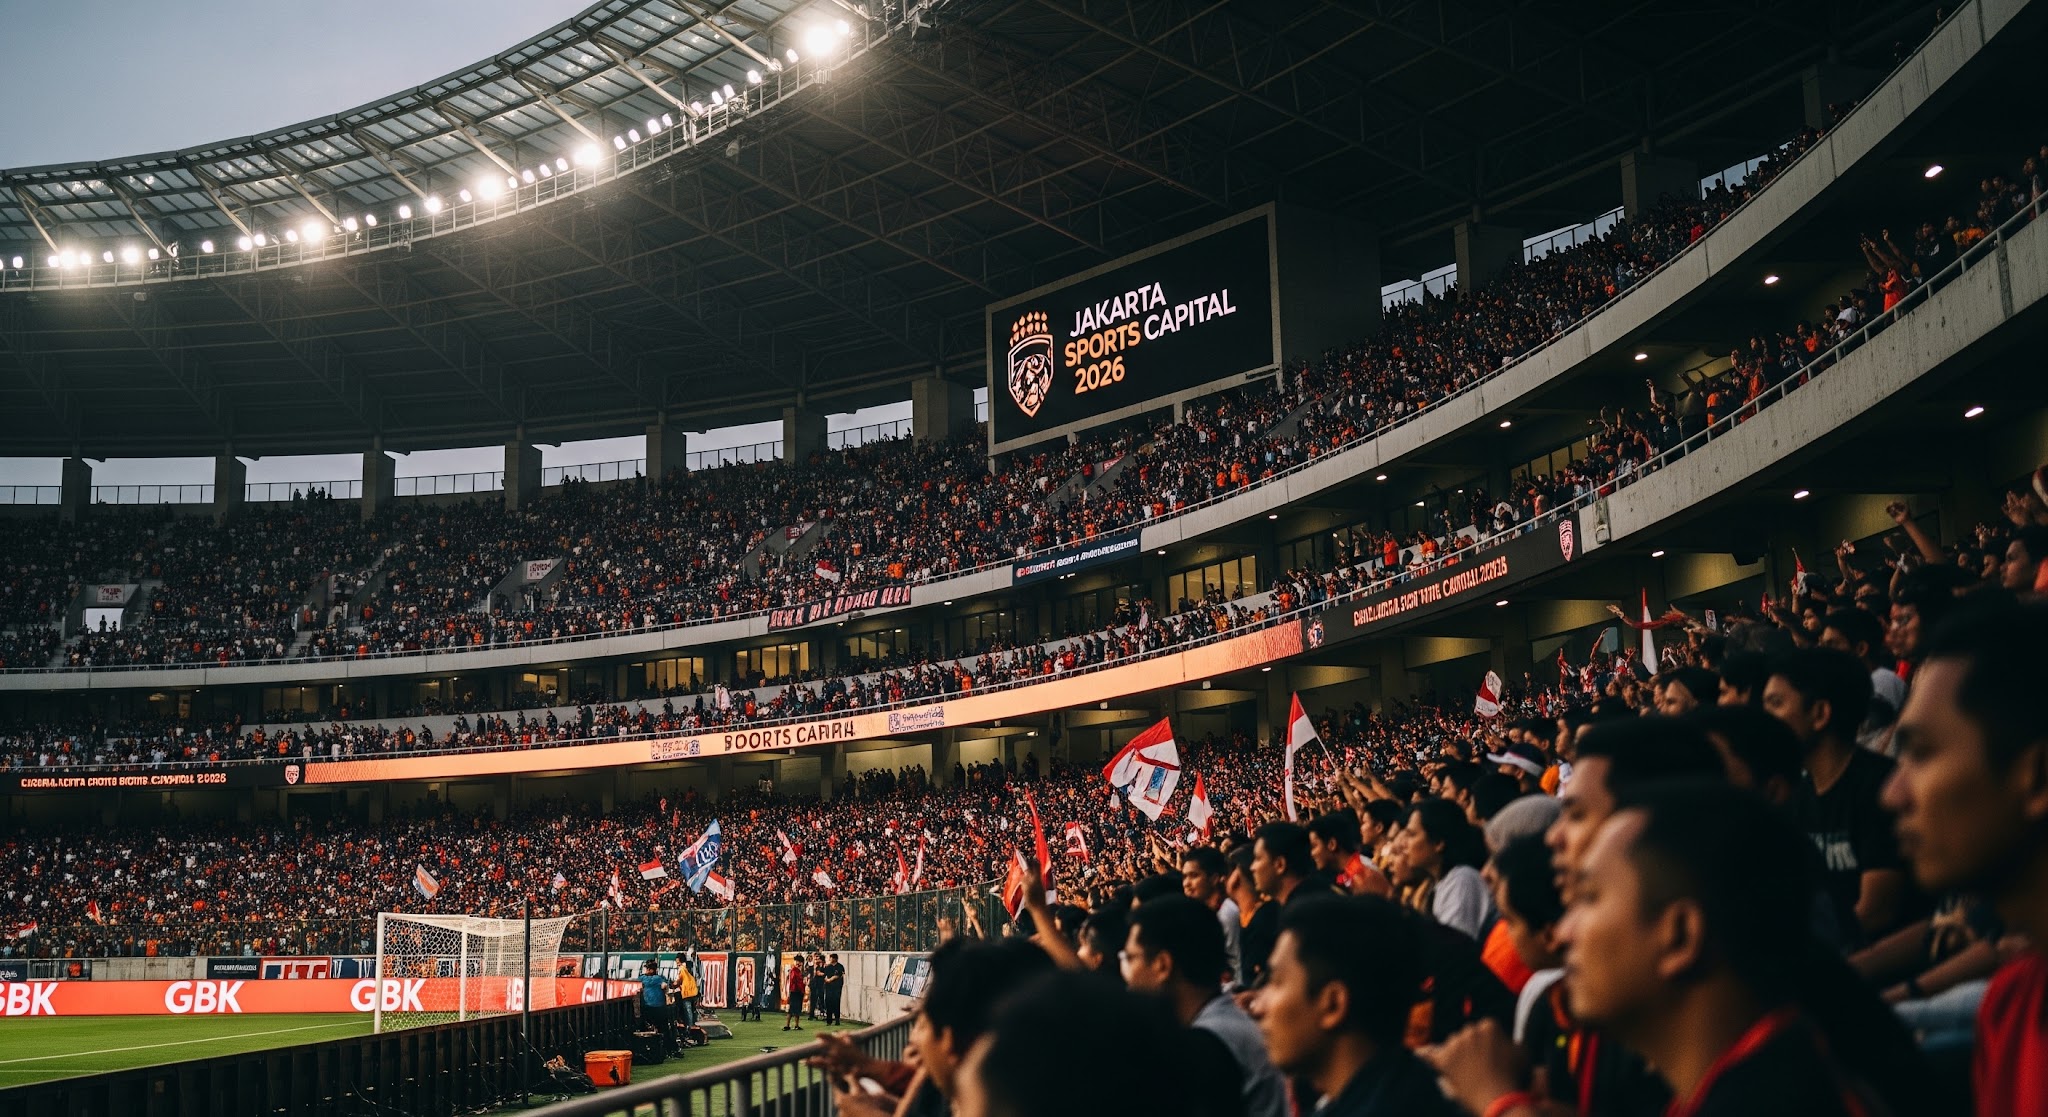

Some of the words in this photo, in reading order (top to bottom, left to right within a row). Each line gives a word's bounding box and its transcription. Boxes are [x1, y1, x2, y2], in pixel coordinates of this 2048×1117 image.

[1070, 282, 1167, 338] JAKARTA
[1064, 321, 1142, 367] SPORTS
[1144, 289, 1237, 340] CAPITAL
[1075, 356, 1126, 394] 2026
[0, 983, 59, 1015] BK
[165, 981, 246, 1013] GBK
[350, 979, 427, 1012] GBK
